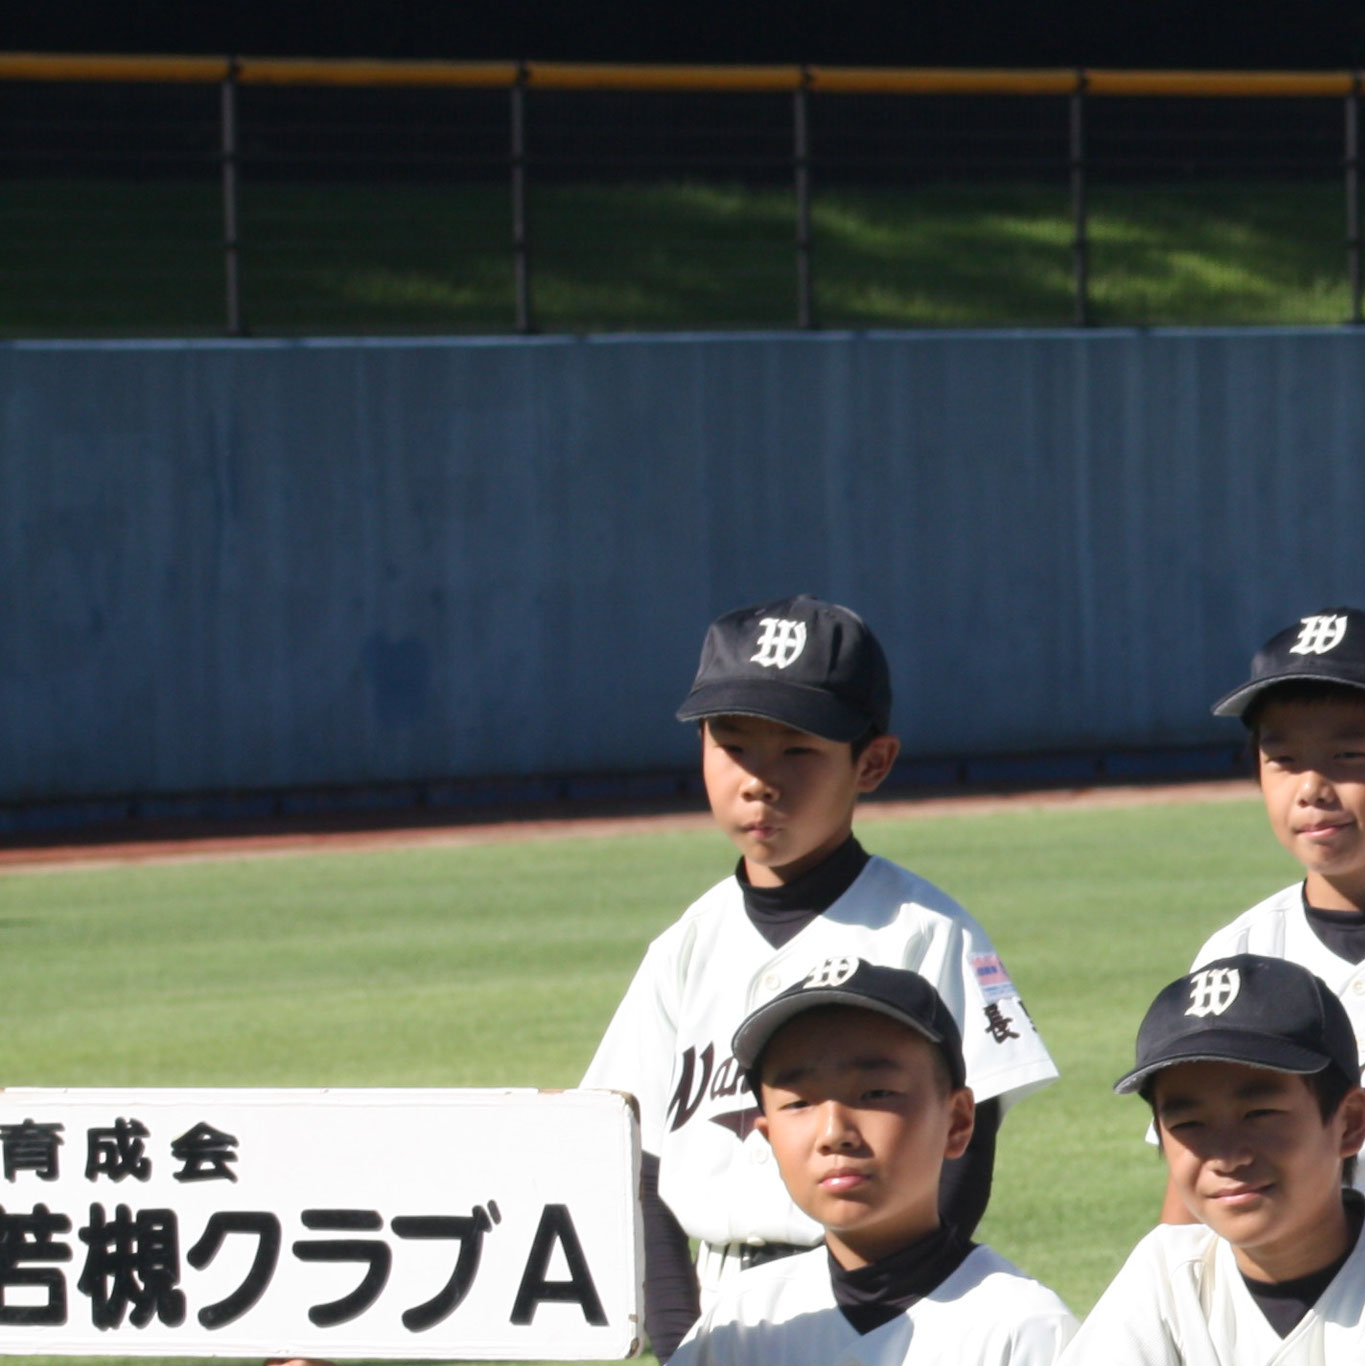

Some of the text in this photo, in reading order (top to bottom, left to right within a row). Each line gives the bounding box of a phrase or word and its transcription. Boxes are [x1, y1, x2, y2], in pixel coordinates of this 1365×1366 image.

[750, 617, 806, 669] W
[1289, 614, 1347, 655] W
[803, 955, 860, 990] W
[1184, 967, 1241, 1018] W
[0, 1118, 240, 1183] 育成会
